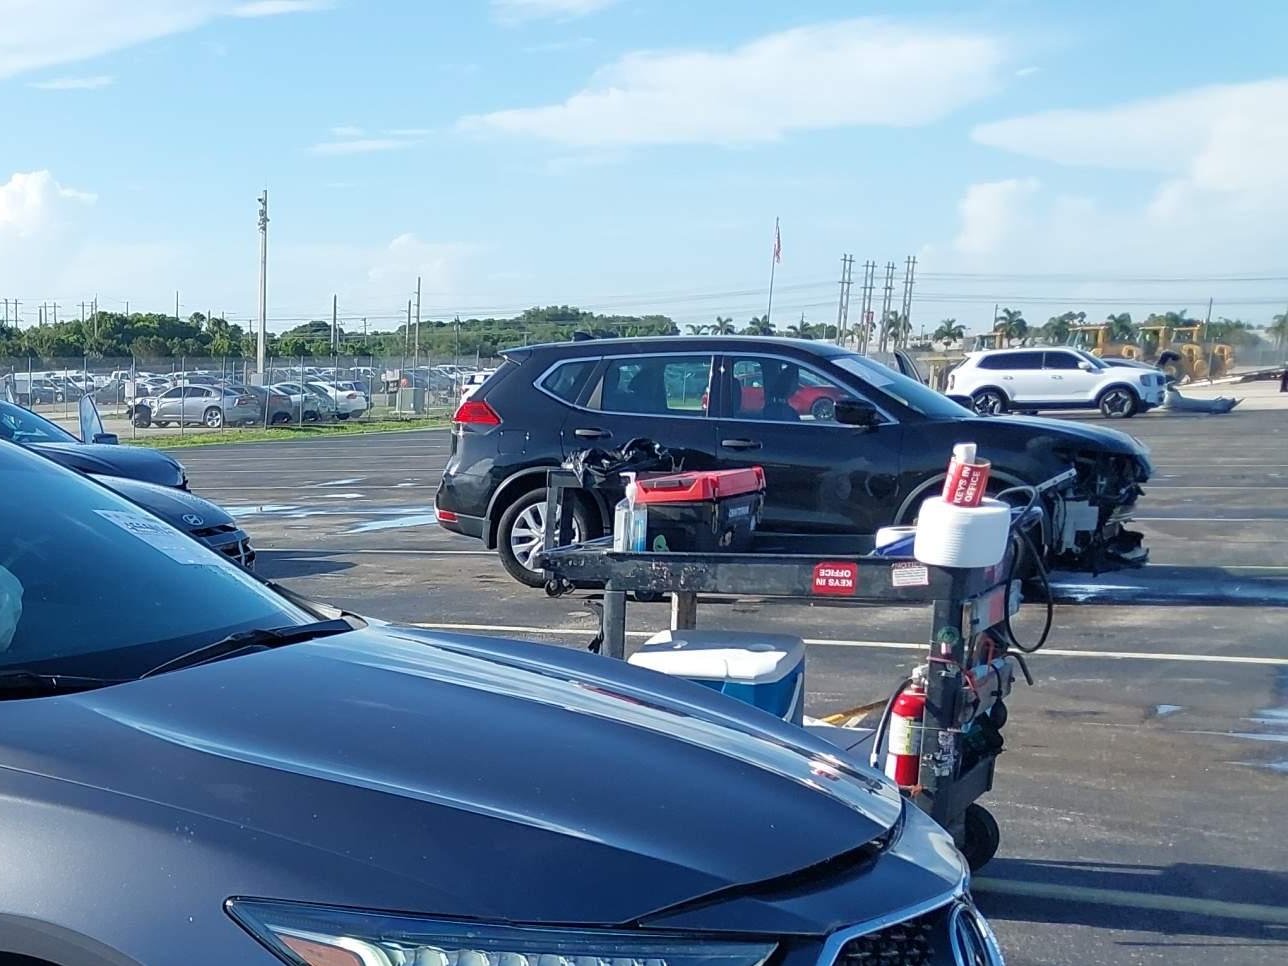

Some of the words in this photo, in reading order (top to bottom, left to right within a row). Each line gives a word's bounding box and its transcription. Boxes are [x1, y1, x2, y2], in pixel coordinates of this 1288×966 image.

[953, 479, 968, 504] KEYS
[962, 466, 971, 478] IN
[964, 471, 981, 502] OFFICE
[819, 568, 852, 577] OFFICE
[815, 577, 826, 586] IN
[828, 578, 853, 587] KEYS
